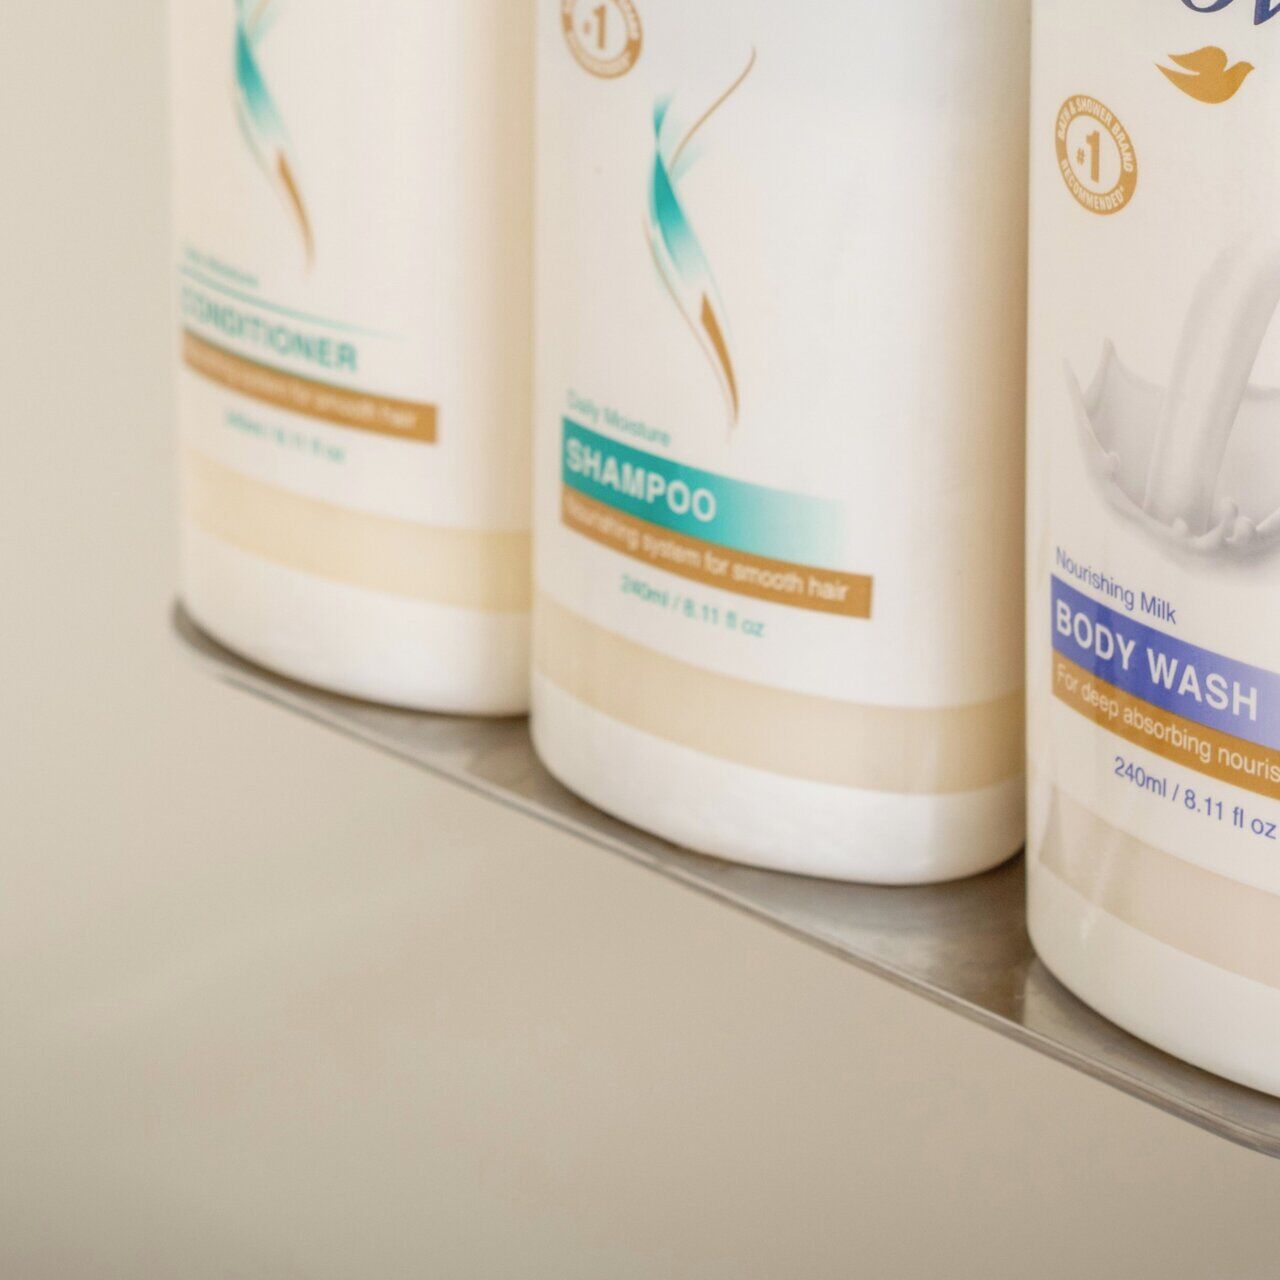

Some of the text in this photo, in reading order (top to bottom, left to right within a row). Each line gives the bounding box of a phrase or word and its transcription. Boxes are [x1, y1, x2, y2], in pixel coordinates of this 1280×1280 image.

[1075, 97, 1113, 127] SHOWER
[1111, 122, 1134, 173] BRAND
[1076, 129, 1101, 184] #1
[566, 437, 717, 523] SHAMPOO
[619, 574, 670, 607] 240ml
[683, 598, 720, 627] 8.11
[742, 619, 766, 637] oz
[642, 532, 702, 568] system
[704, 549, 730, 576] for
[732, 560, 805, 596] smooth
[807, 573, 850, 603] hair
[1056, 546, 1177, 625] Nourishing Milk
[1055, 598, 1258, 721] BODY WASH
[1056, 661, 1080, 693] For
[1081, 679, 1120, 721] deep
[1123, 700, 1212, 764] absorbing
[1114, 756, 1167, 800] 240ml
[1184, 789, 1224, 821] 8.11
[1233, 806, 1245, 829] fl
[1251, 818, 1277, 840] oz
